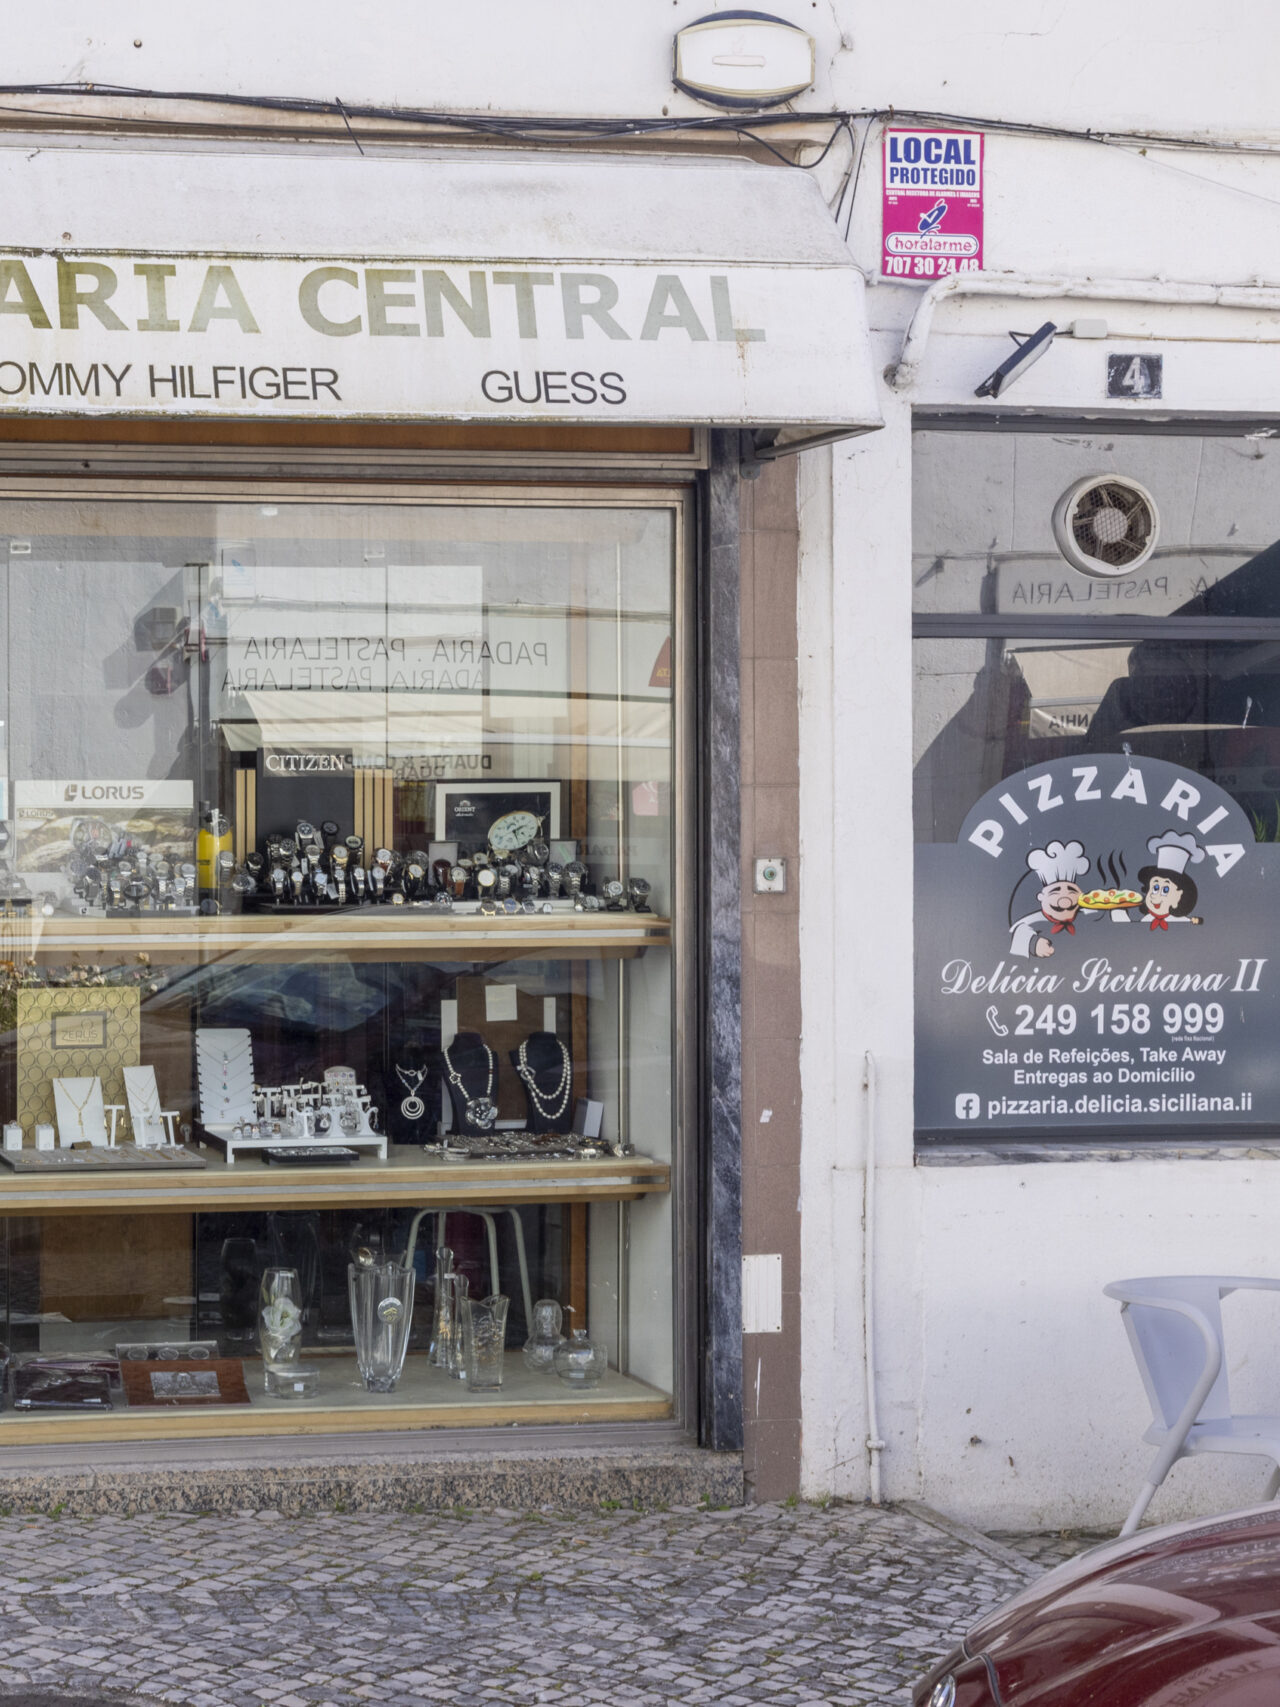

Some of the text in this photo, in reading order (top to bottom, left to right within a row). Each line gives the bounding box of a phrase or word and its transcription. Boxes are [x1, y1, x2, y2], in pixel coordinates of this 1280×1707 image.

[890, 137, 976, 165] LOCAL
[890, 167, 976, 186] PROTEGIDO
[895, 236, 972, 252] horalarme
[885, 257, 911, 274] 707
[914, 257, 934, 275] 30
[298, 265, 767, 343] CENTRAL
[148, 364, 342, 401] HILFIGER
[481, 370, 628, 405] GUESS
[1122, 356, 1149, 392] 4
[265, 754, 345, 772] CITIZEN
[81, 785, 145, 800] LORUS
[968, 766, 1246, 878] PIZZARIA
[941, 957, 1268, 996] Delícia Siciliana II
[1014, 1003, 1225, 1036] 249 158 999
[982, 1047, 1226, 1068] Sala de Refeições, Take Away
[1014, 1067, 1195, 1088] Entregas ao Domicílio
[988, 1093, 1253, 1119] pizzaria.delicia.siciliana.ii
